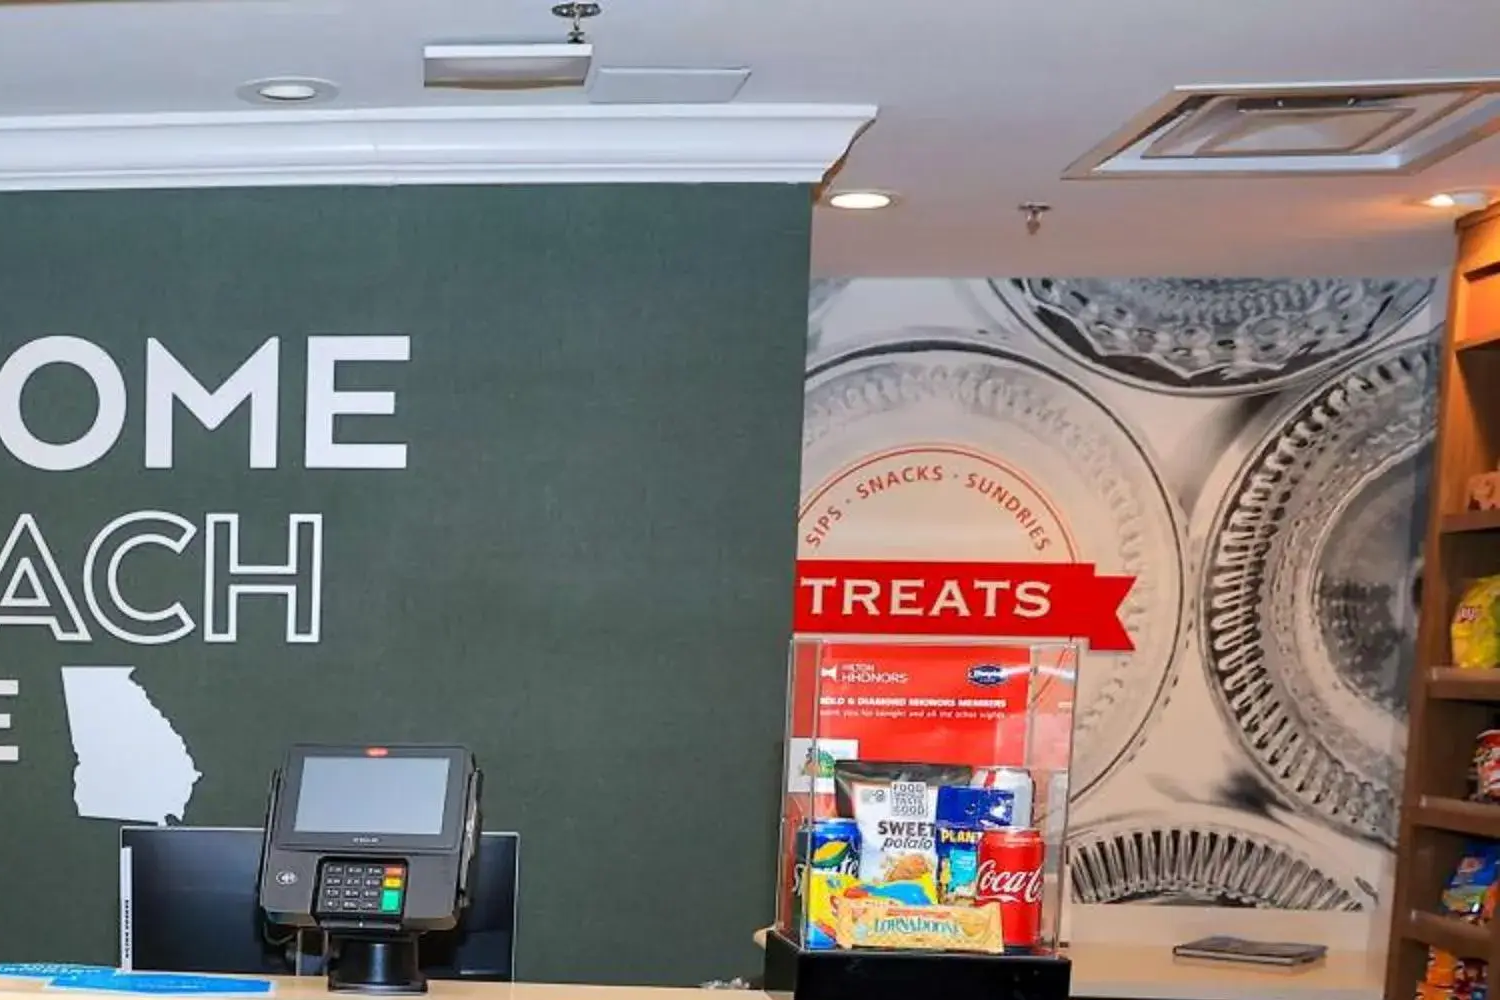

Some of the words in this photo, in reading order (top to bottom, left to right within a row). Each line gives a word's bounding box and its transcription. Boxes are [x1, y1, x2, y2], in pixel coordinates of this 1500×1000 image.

[805, 506, 843, 548] SIPS
[856, 464, 944, 500] SNACKS
[964, 472, 1053, 552] SUNDRIES
[799, 576, 1052, 618] TREATS
[877, 821, 936, 837] SWEET
[880, 837, 933, 852] potato
